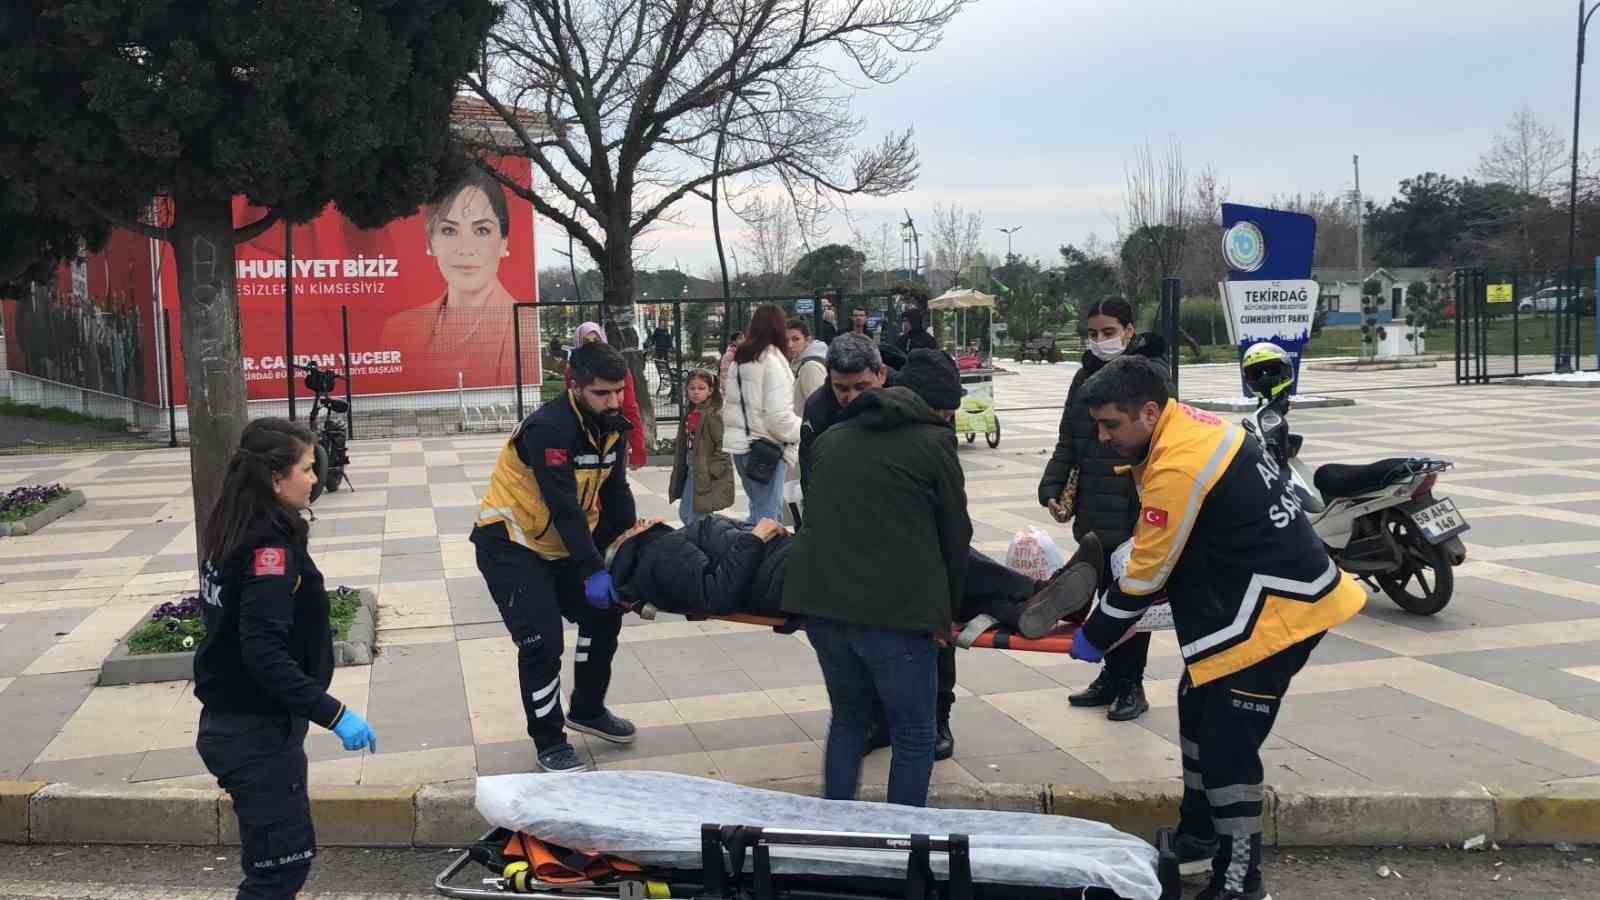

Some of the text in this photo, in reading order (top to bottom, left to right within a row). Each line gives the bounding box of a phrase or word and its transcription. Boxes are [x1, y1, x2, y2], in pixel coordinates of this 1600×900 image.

[236, 254, 399, 279] HURİYET BİZİZ
[238, 281, 385, 296] SİZLERN KİMSESİYİZ
[1245, 287, 1308, 302] TEKİRDAĞ
[1430, 502, 1454, 519] AHL
